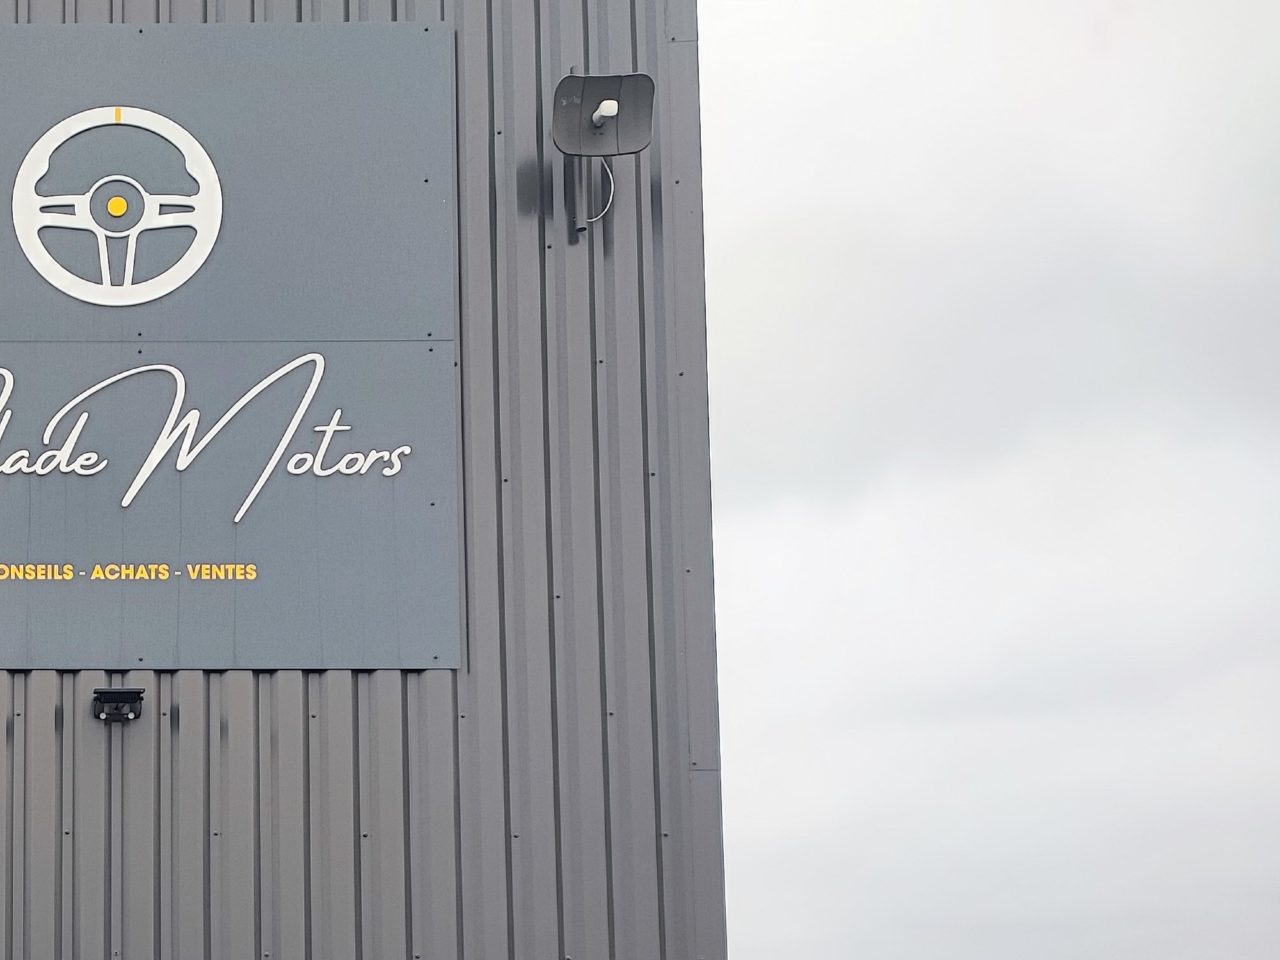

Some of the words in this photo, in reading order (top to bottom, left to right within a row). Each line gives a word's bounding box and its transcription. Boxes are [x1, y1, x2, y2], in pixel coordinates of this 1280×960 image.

[43, 353, 412, 523] Motors
[90, 563, 170, 580] ACHATS
[186, 563, 257, 580] VENTES
